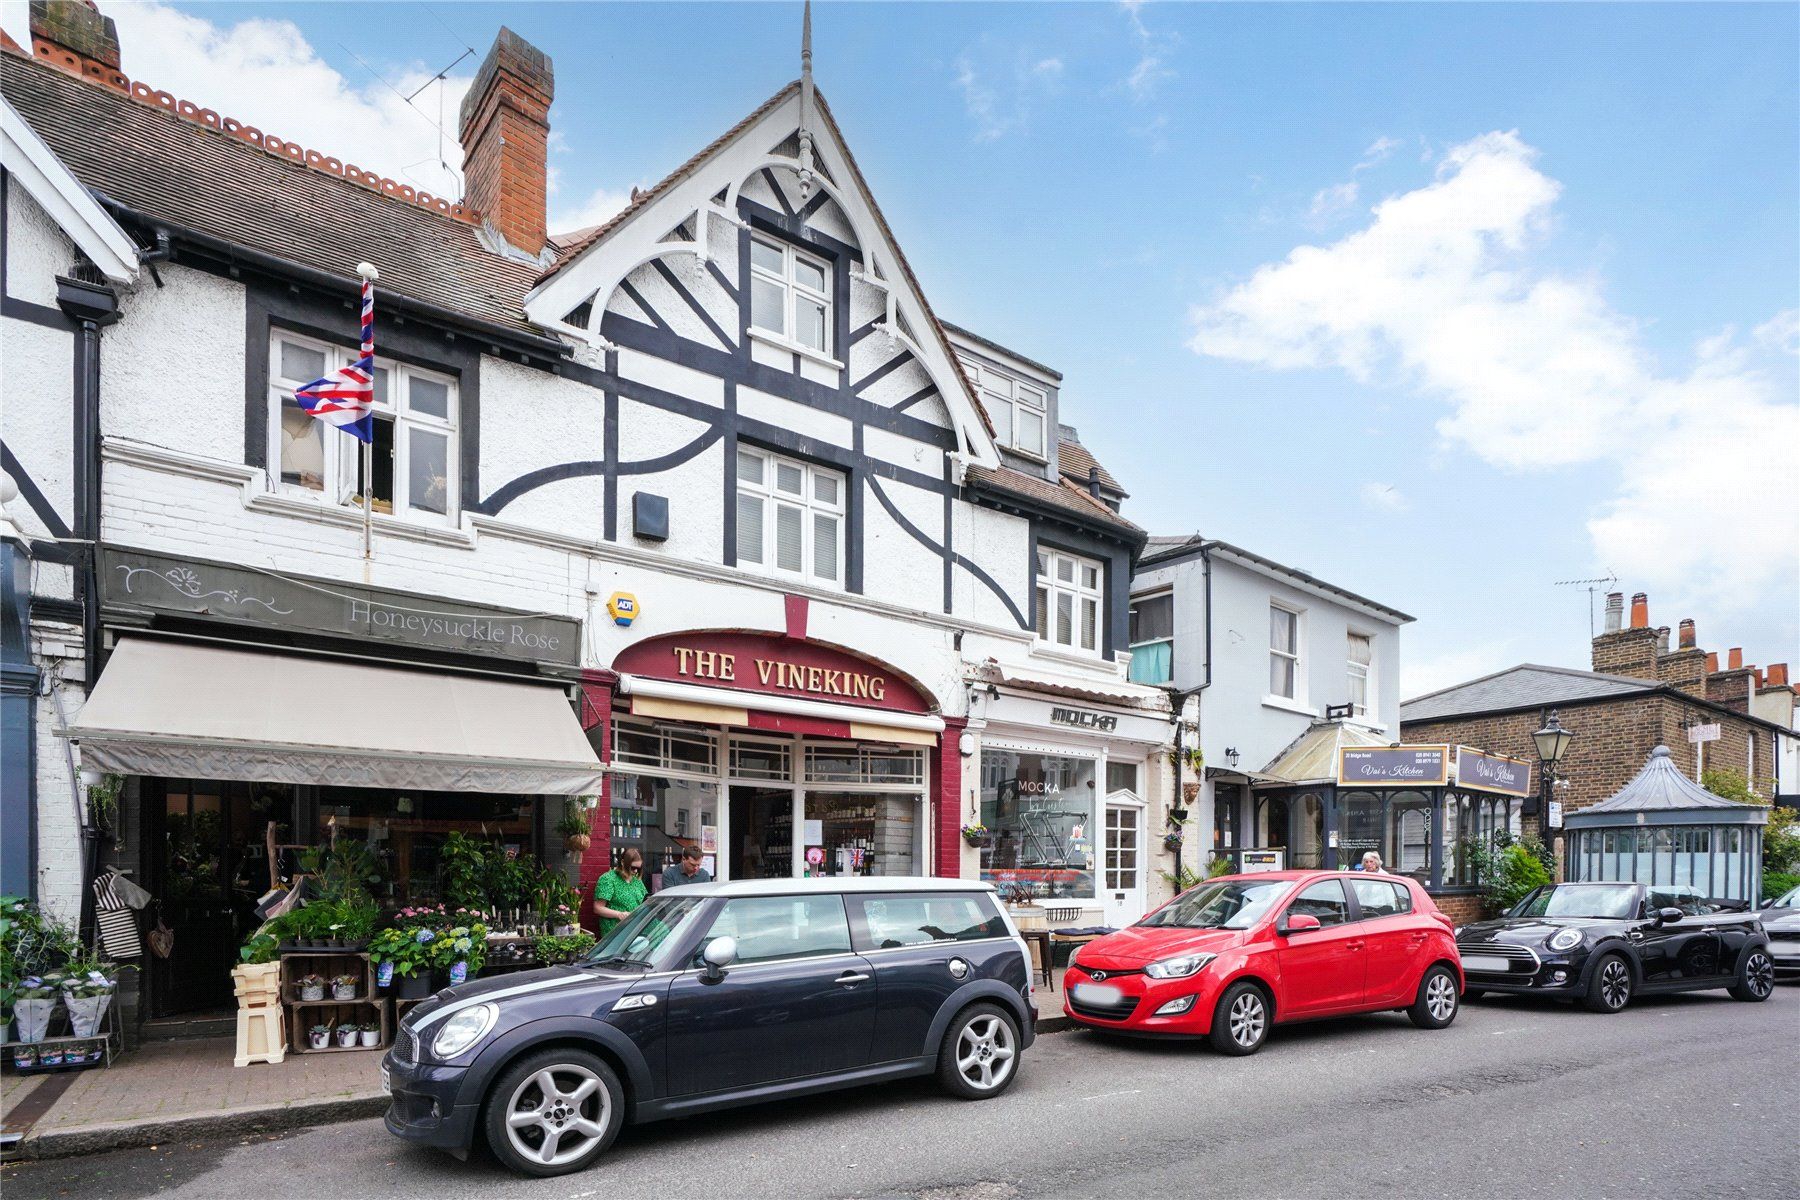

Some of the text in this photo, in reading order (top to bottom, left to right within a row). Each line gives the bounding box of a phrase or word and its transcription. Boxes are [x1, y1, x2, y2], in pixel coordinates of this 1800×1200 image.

[618, 600, 632, 610] ADT
[351, 600, 559, 651] Honeysuckle Rose
[674, 646, 886, 701] THE VINEKING
[1051, 707, 1118, 730] MOCKA
[1389, 764, 1424, 777] Kitchen
[1494, 764, 1515, 782] Kitchen
[1018, 780, 1060, 794] MOCKA
